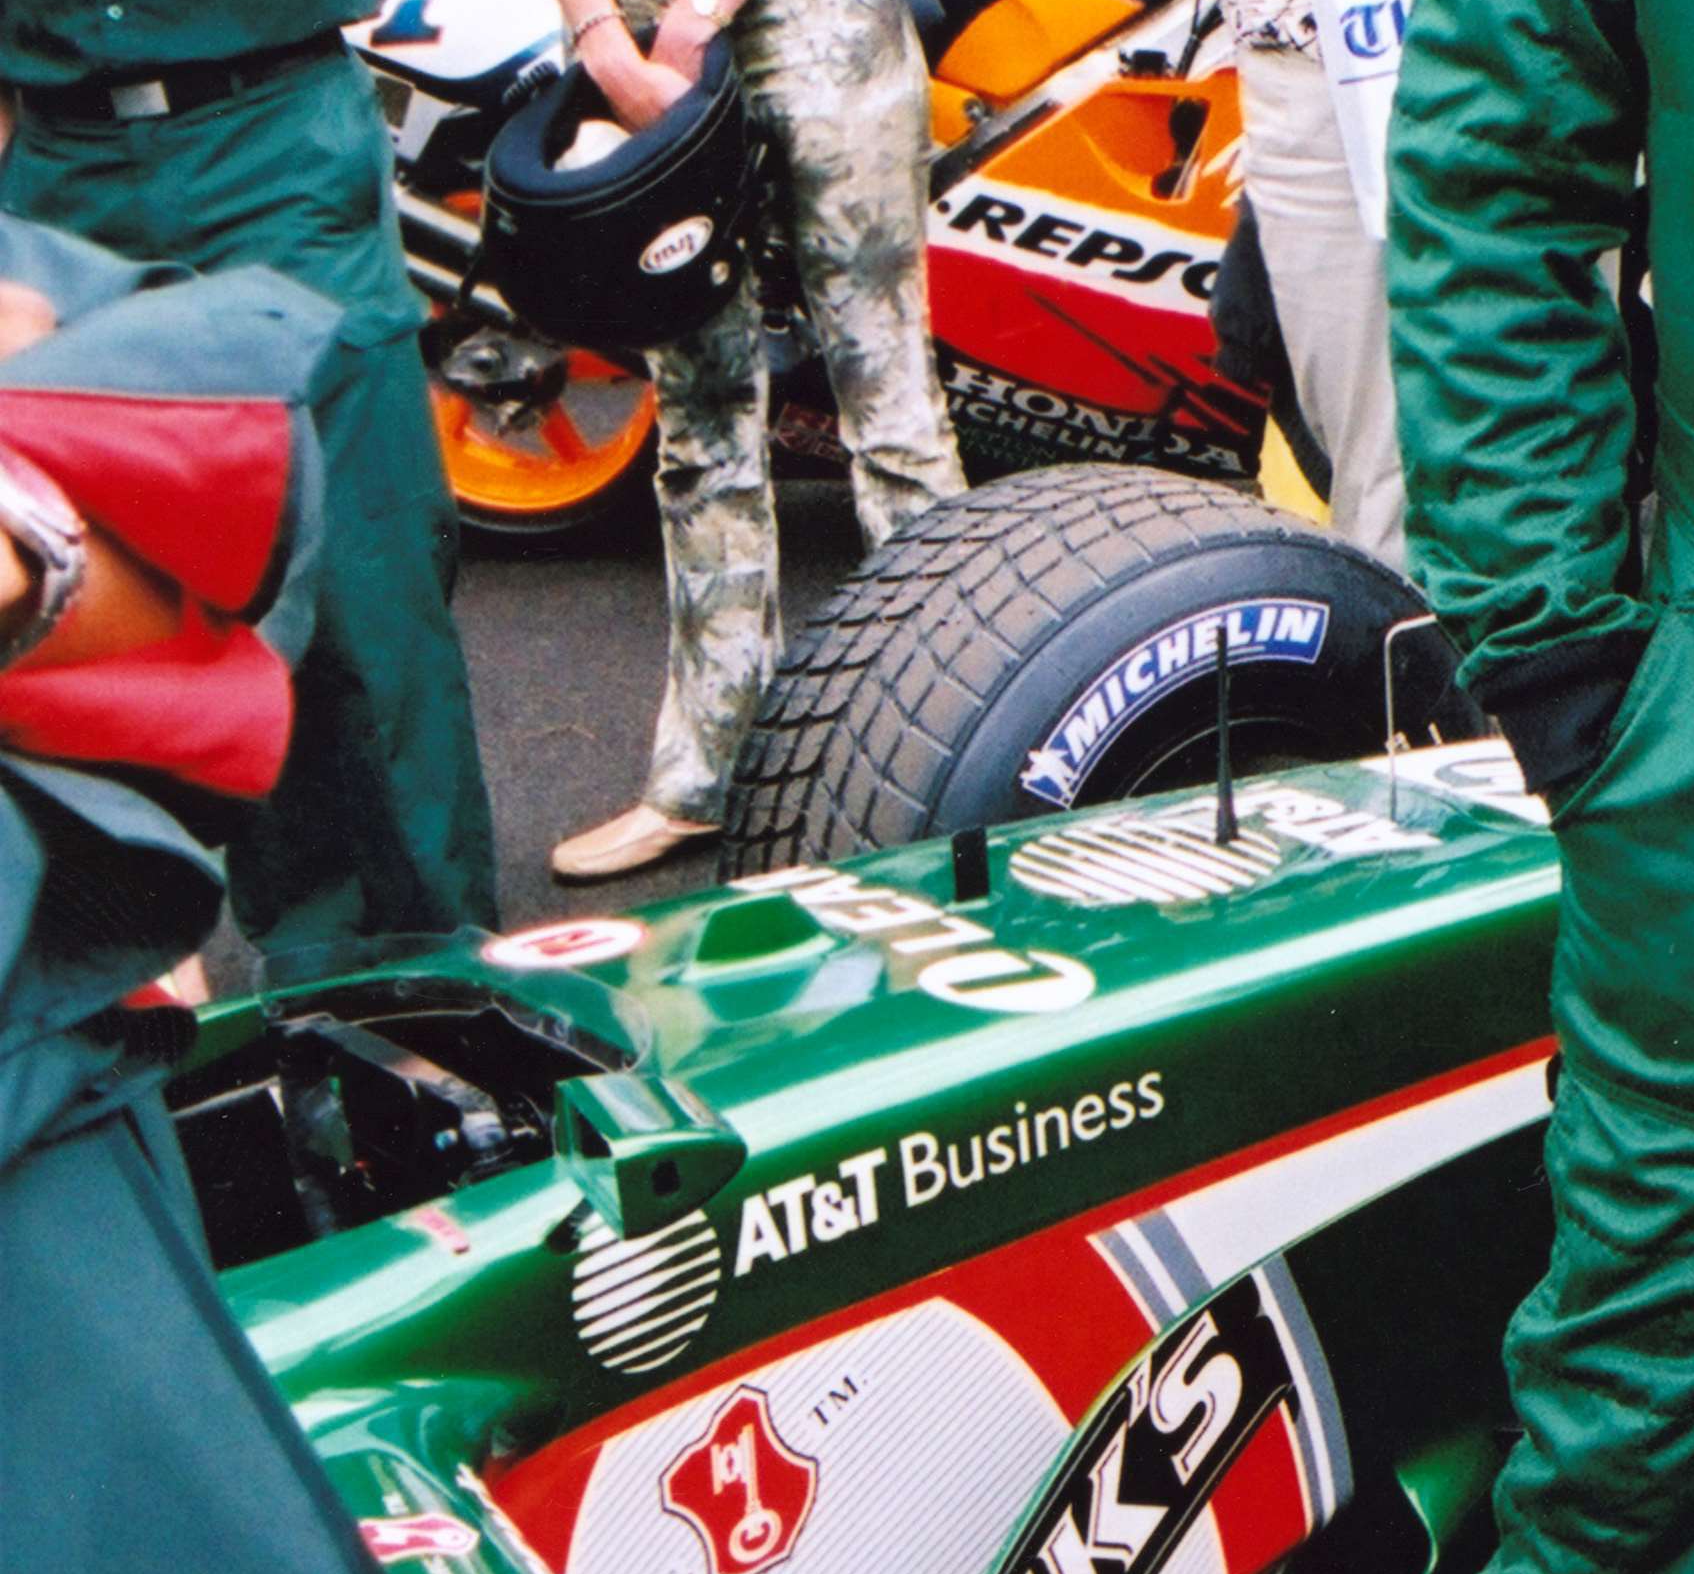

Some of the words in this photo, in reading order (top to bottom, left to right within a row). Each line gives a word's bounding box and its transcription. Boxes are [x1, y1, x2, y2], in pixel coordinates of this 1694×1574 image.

[1062, 606, 1321, 764] MICHELIN
[733, 1149, 887, 1278] AT&T
[905, 1069, 1165, 1207] Business
